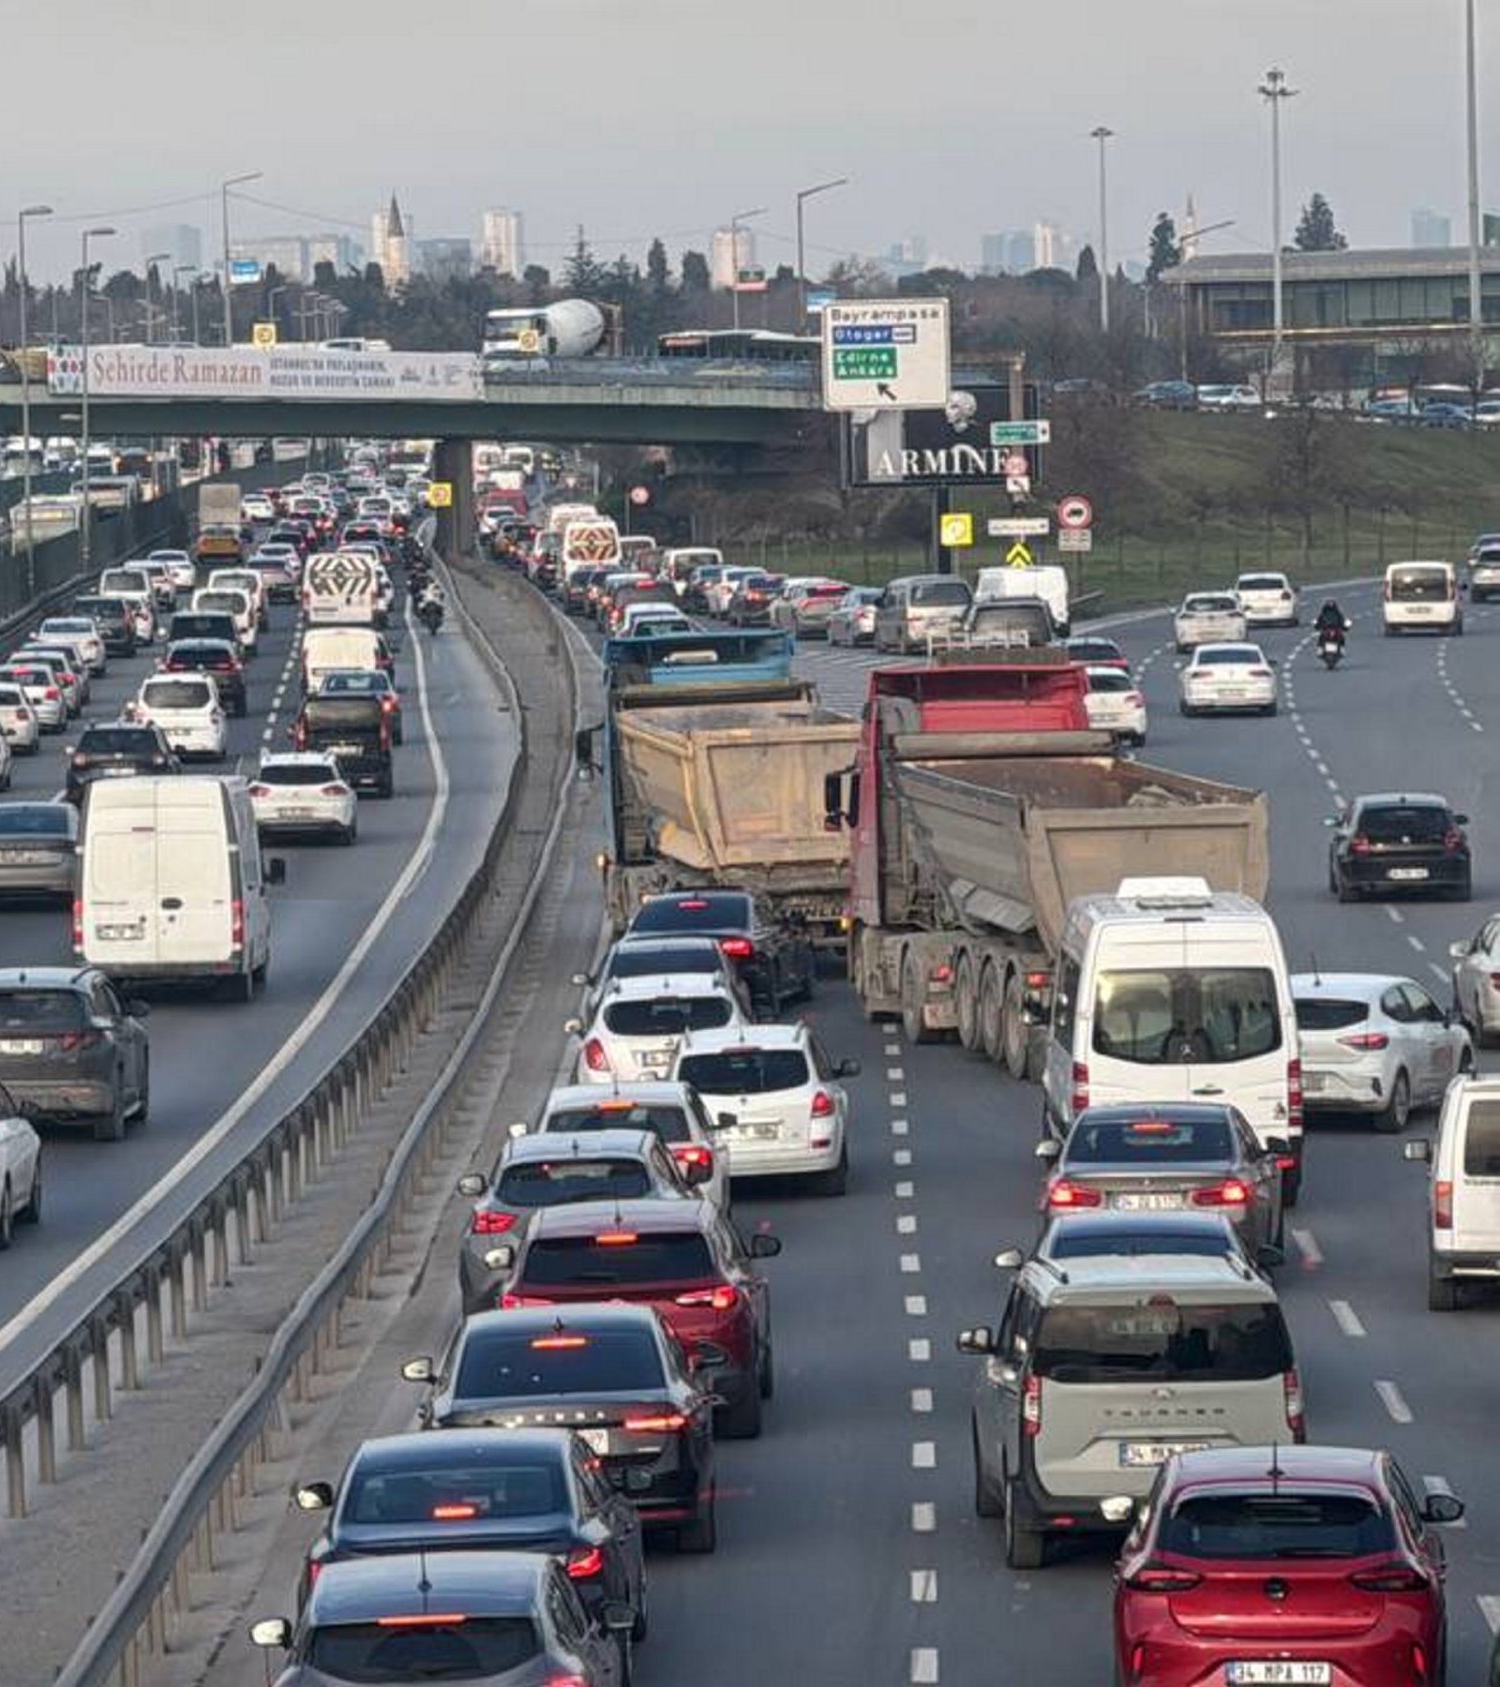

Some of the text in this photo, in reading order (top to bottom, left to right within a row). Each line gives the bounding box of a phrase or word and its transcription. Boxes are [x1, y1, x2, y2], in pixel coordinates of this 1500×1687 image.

[93, 353, 263, 385] Şehirde Ramazan
[838, 366, 894, 376] Ankara
[1237, 1666, 1324, 1680] 34 MPA 117
